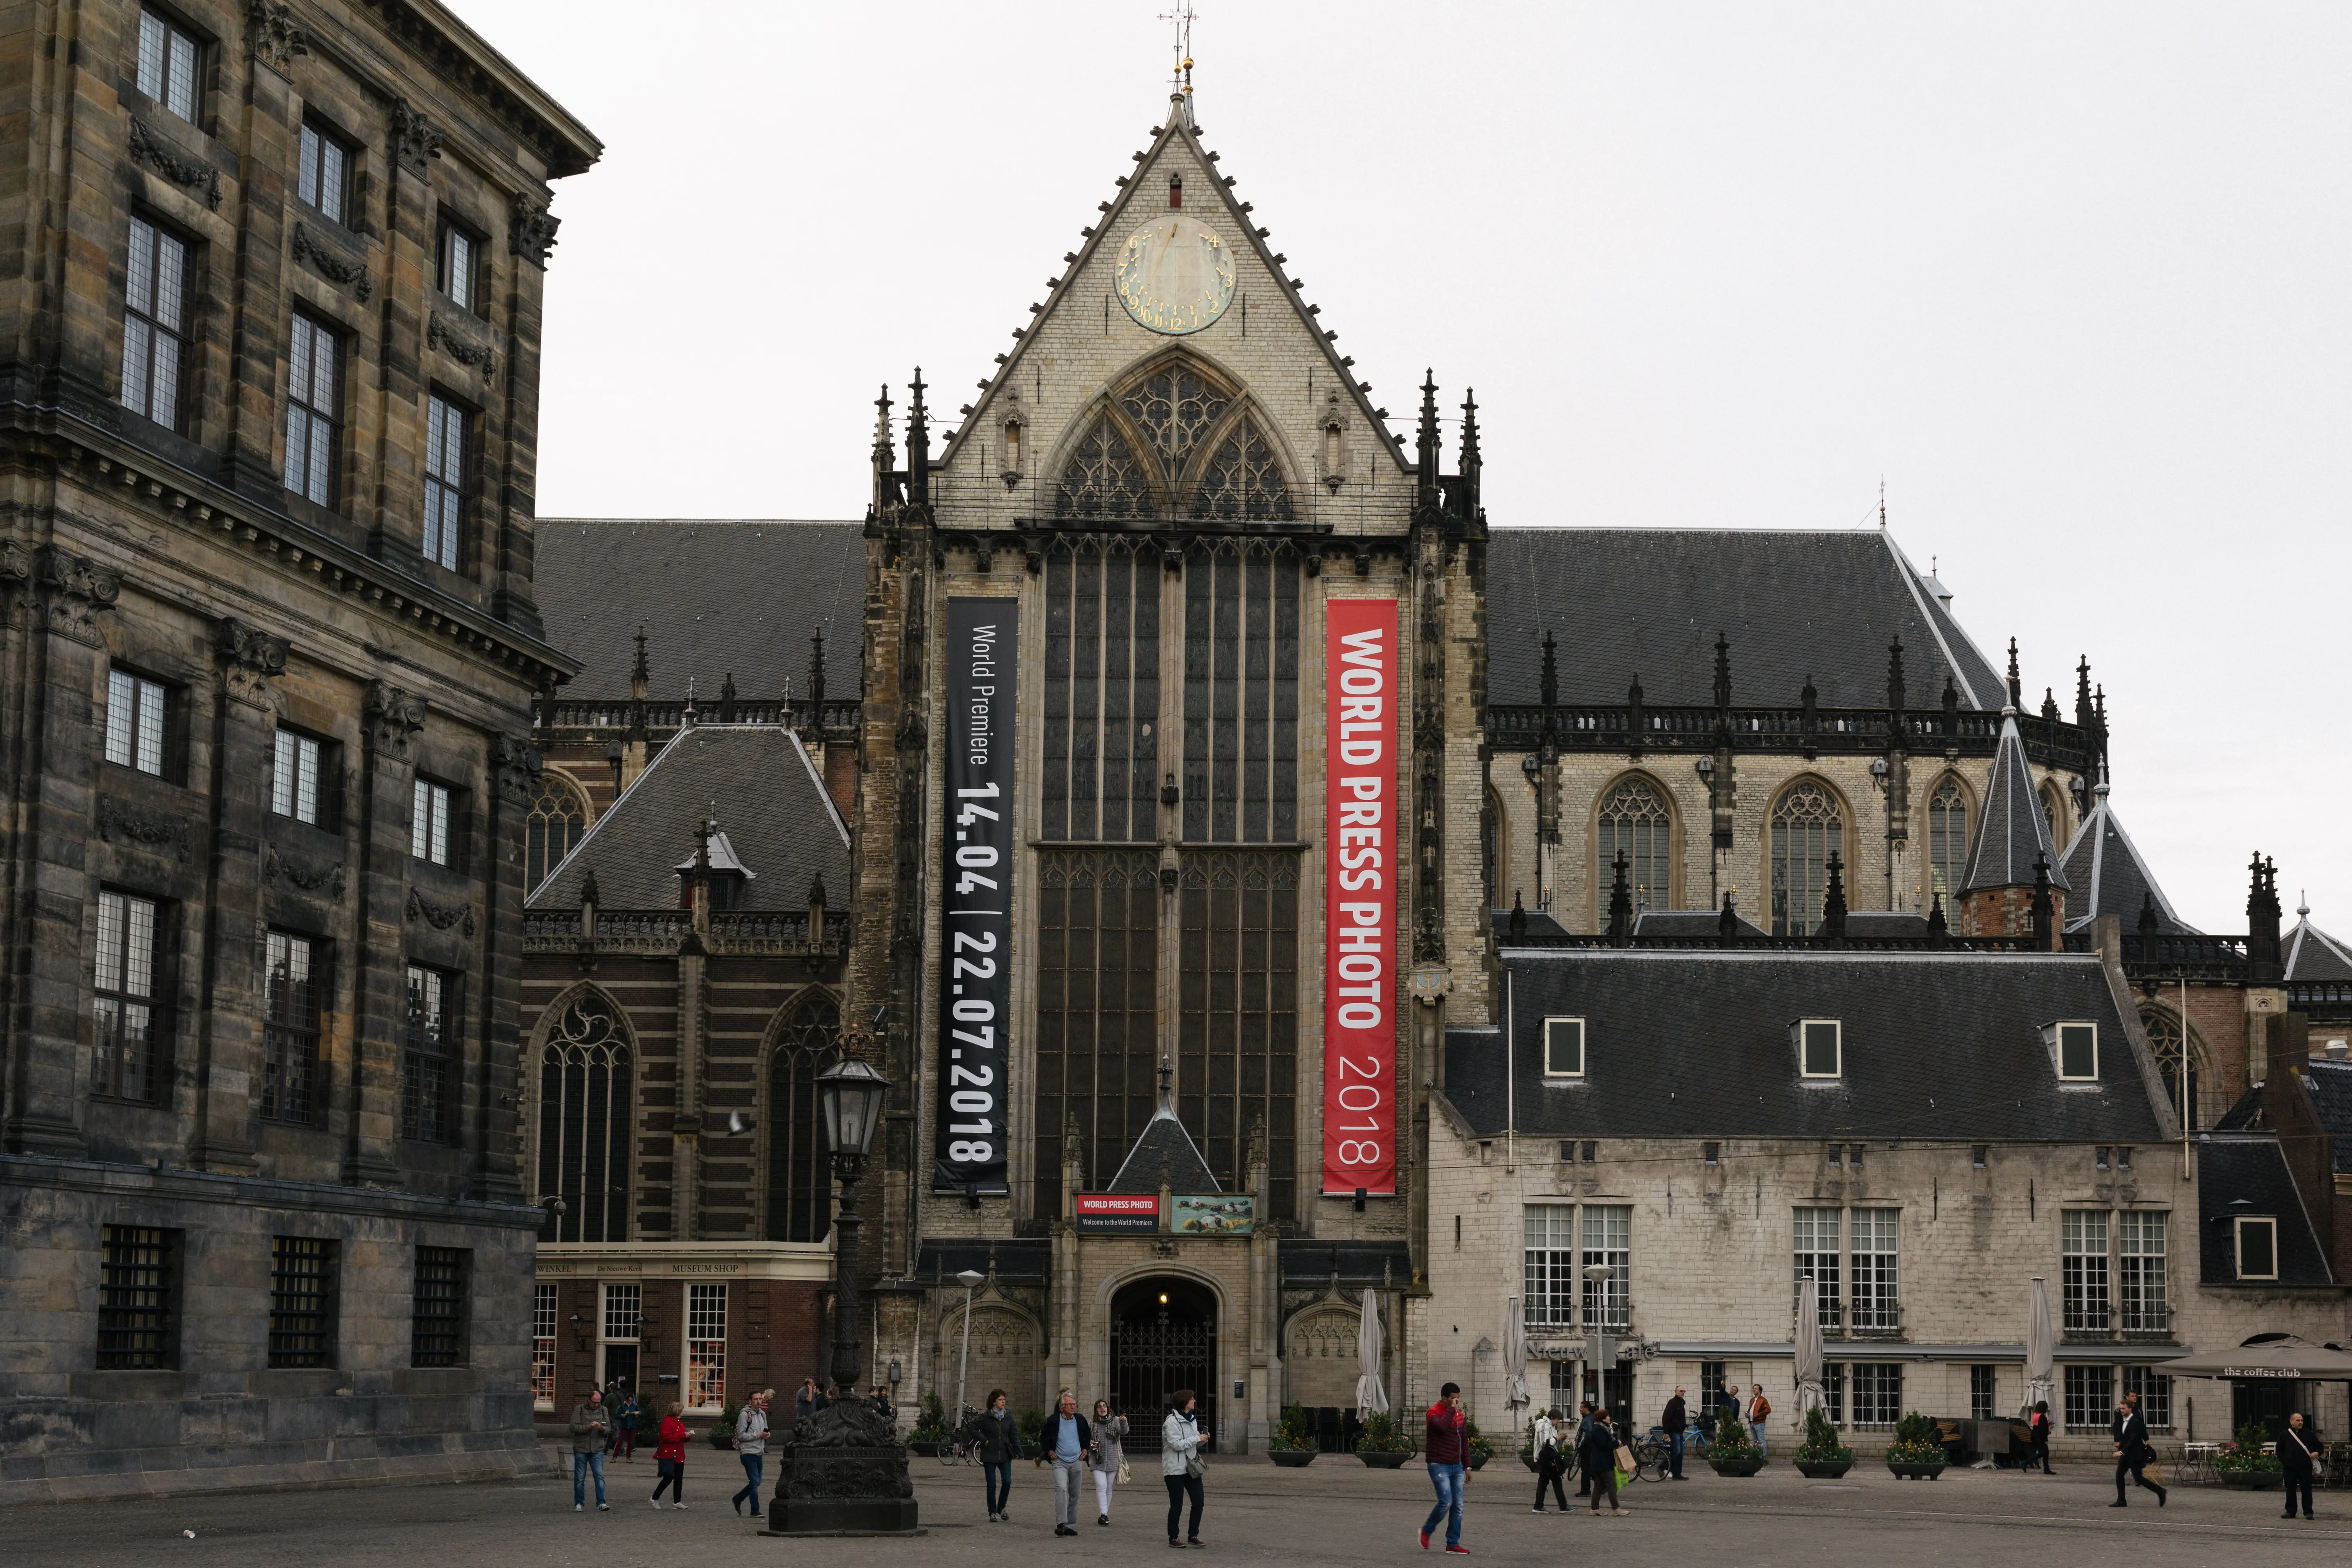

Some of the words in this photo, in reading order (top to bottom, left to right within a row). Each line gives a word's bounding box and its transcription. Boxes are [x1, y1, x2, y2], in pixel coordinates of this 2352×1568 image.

[1129, 235, 1140, 249] 6
[1209, 235, 1219, 248] 4
[1117, 262, 1129, 276] 7
[1225, 274, 1233, 287] 3
[1121, 282, 1129, 296] 8
[1129, 296, 1139, 309] 9
[1209, 301, 1219, 314] 2
[1167, 318, 1183, 331] 12
[972, 625, 996, 677] World
[1339, 628, 1383, 765] WORLD
[970, 686, 995, 765] Premiere
[956, 782, 1000, 894] 14.04
[1339, 776, 1382, 891] PRESS
[1338, 902, 1382, 1029] PHOTO
[949, 931, 997, 1162] 22.07.2018
[1338, 1056, 1380, 1165] 2018
[1526, 1340, 1586, 1359] Nieuw
[2224, 1367, 2241, 1375] the
[2244, 1368, 2276, 1376] coffee
[2278, 1369, 2301, 1377] club
